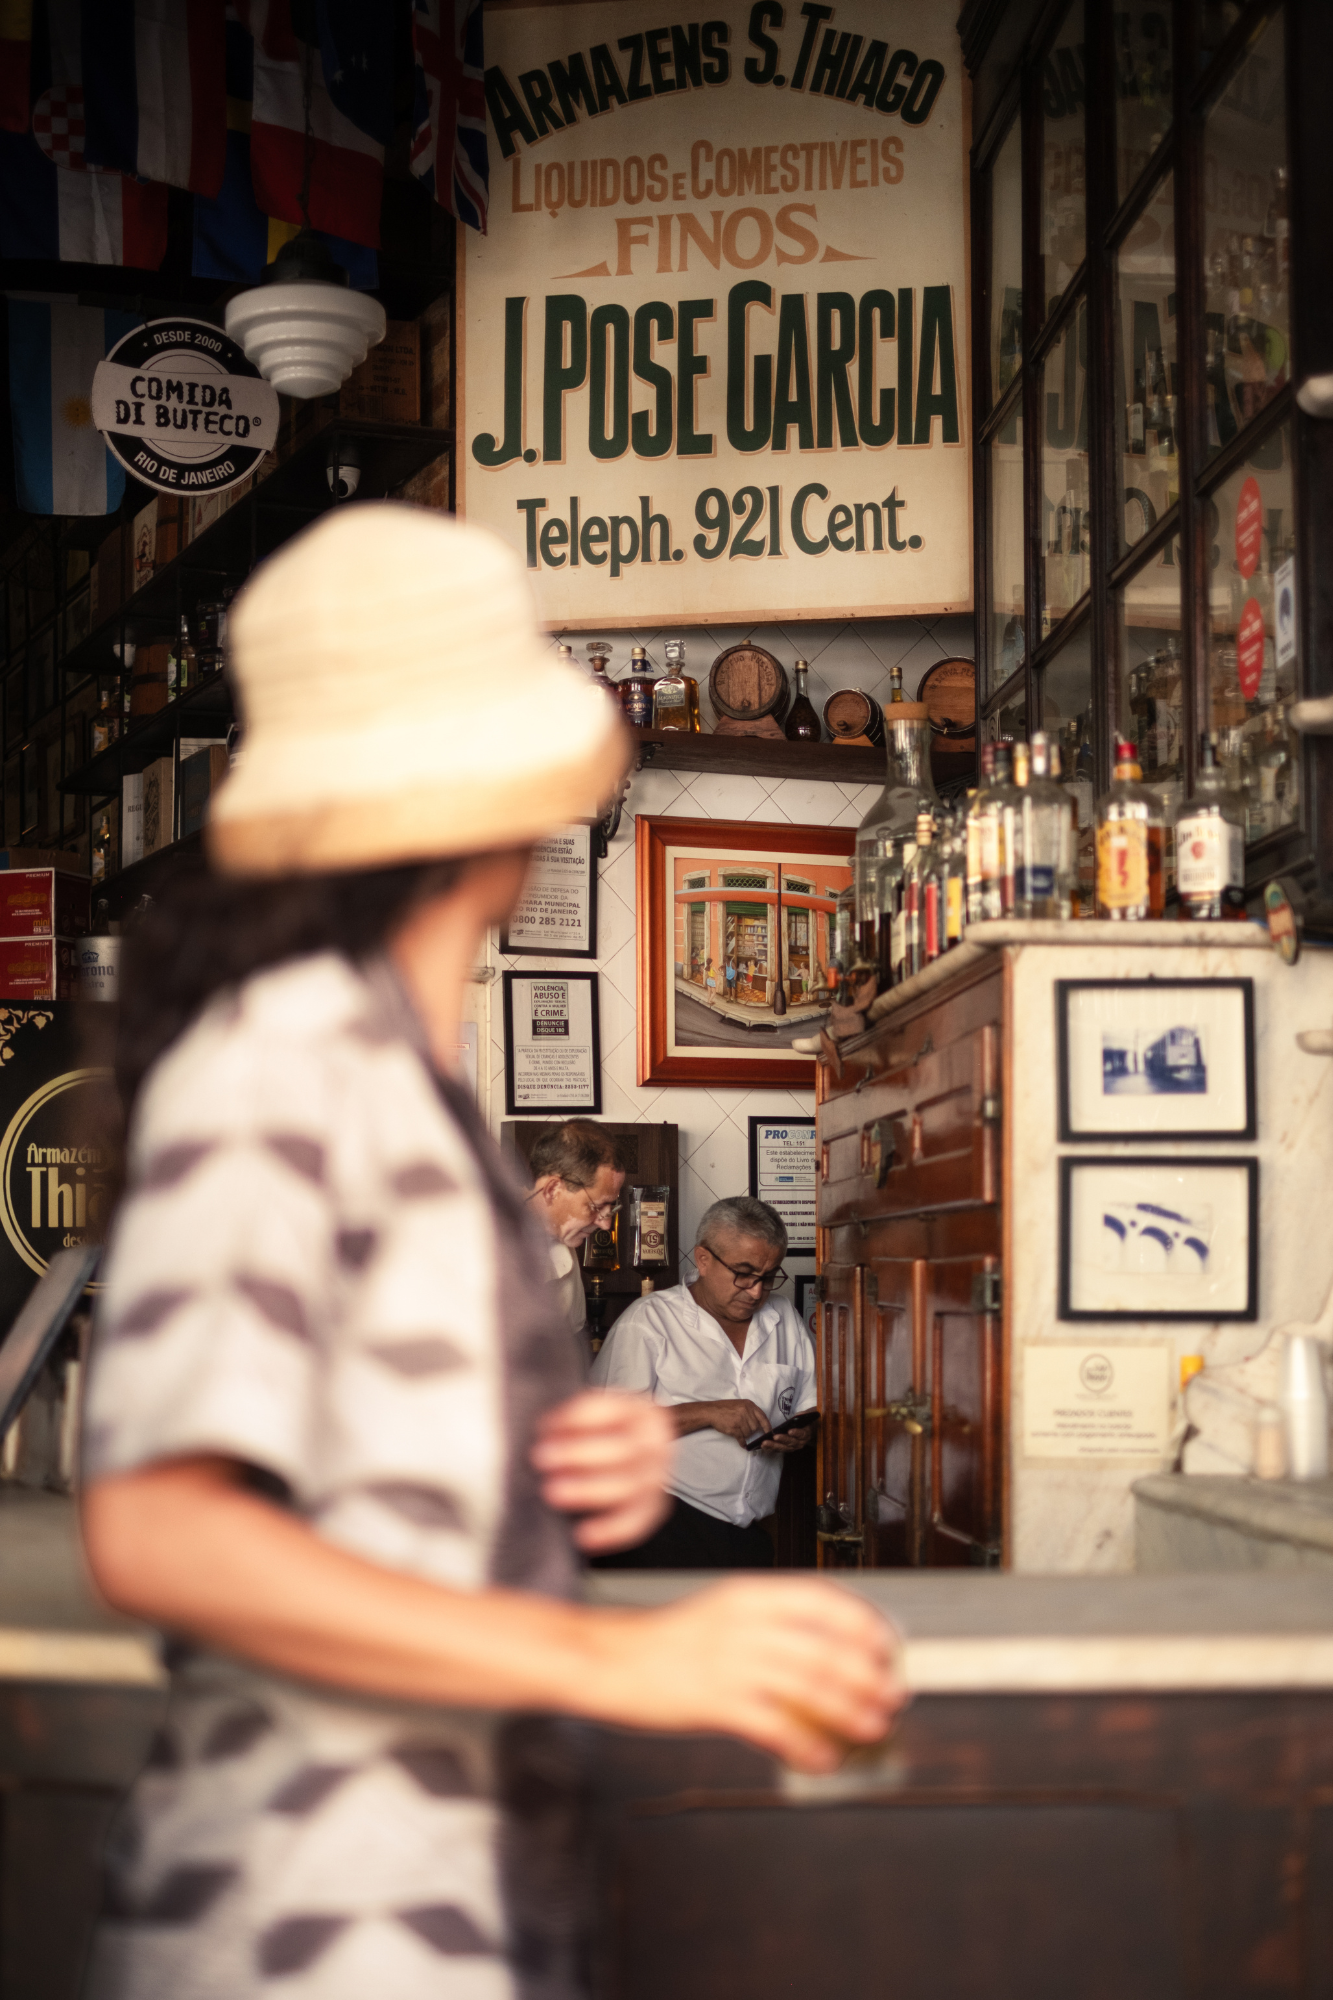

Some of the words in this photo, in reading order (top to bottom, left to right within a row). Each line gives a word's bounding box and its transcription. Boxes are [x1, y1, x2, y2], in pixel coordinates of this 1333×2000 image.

[484, 21, 729, 159] ARMAZENS
[512, 153, 668, 218] LIQUIDOS
[672, 172, 686, 201] E
[691, 136, 904, 200] COMESTIVEIS
[615, 203, 819, 276] FINOS
[153, 331, 191, 345] DESDE
[195, 333, 222, 353] 2000
[727, 279, 961, 455] GARCIA
[130, 376, 232, 410] COMIDA
[115, 400, 145, 426] DI
[134, 451, 158, 473] RIO
[159, 467, 178, 483] DE
[181, 460, 236, 485] JANEIRO
[517, 495, 683, 578] Teleph.
[693, 485, 784, 561] 921
[791, 482, 923, 556] Cent.
[33, 918, 50, 926] mini
[513, 915, 536, 924] 0800
[539, 917, 556, 925] 285
[559, 918, 582, 927] 2121
[34, 987, 50, 995] mini
[648, 1235, 659, 1243] 51
